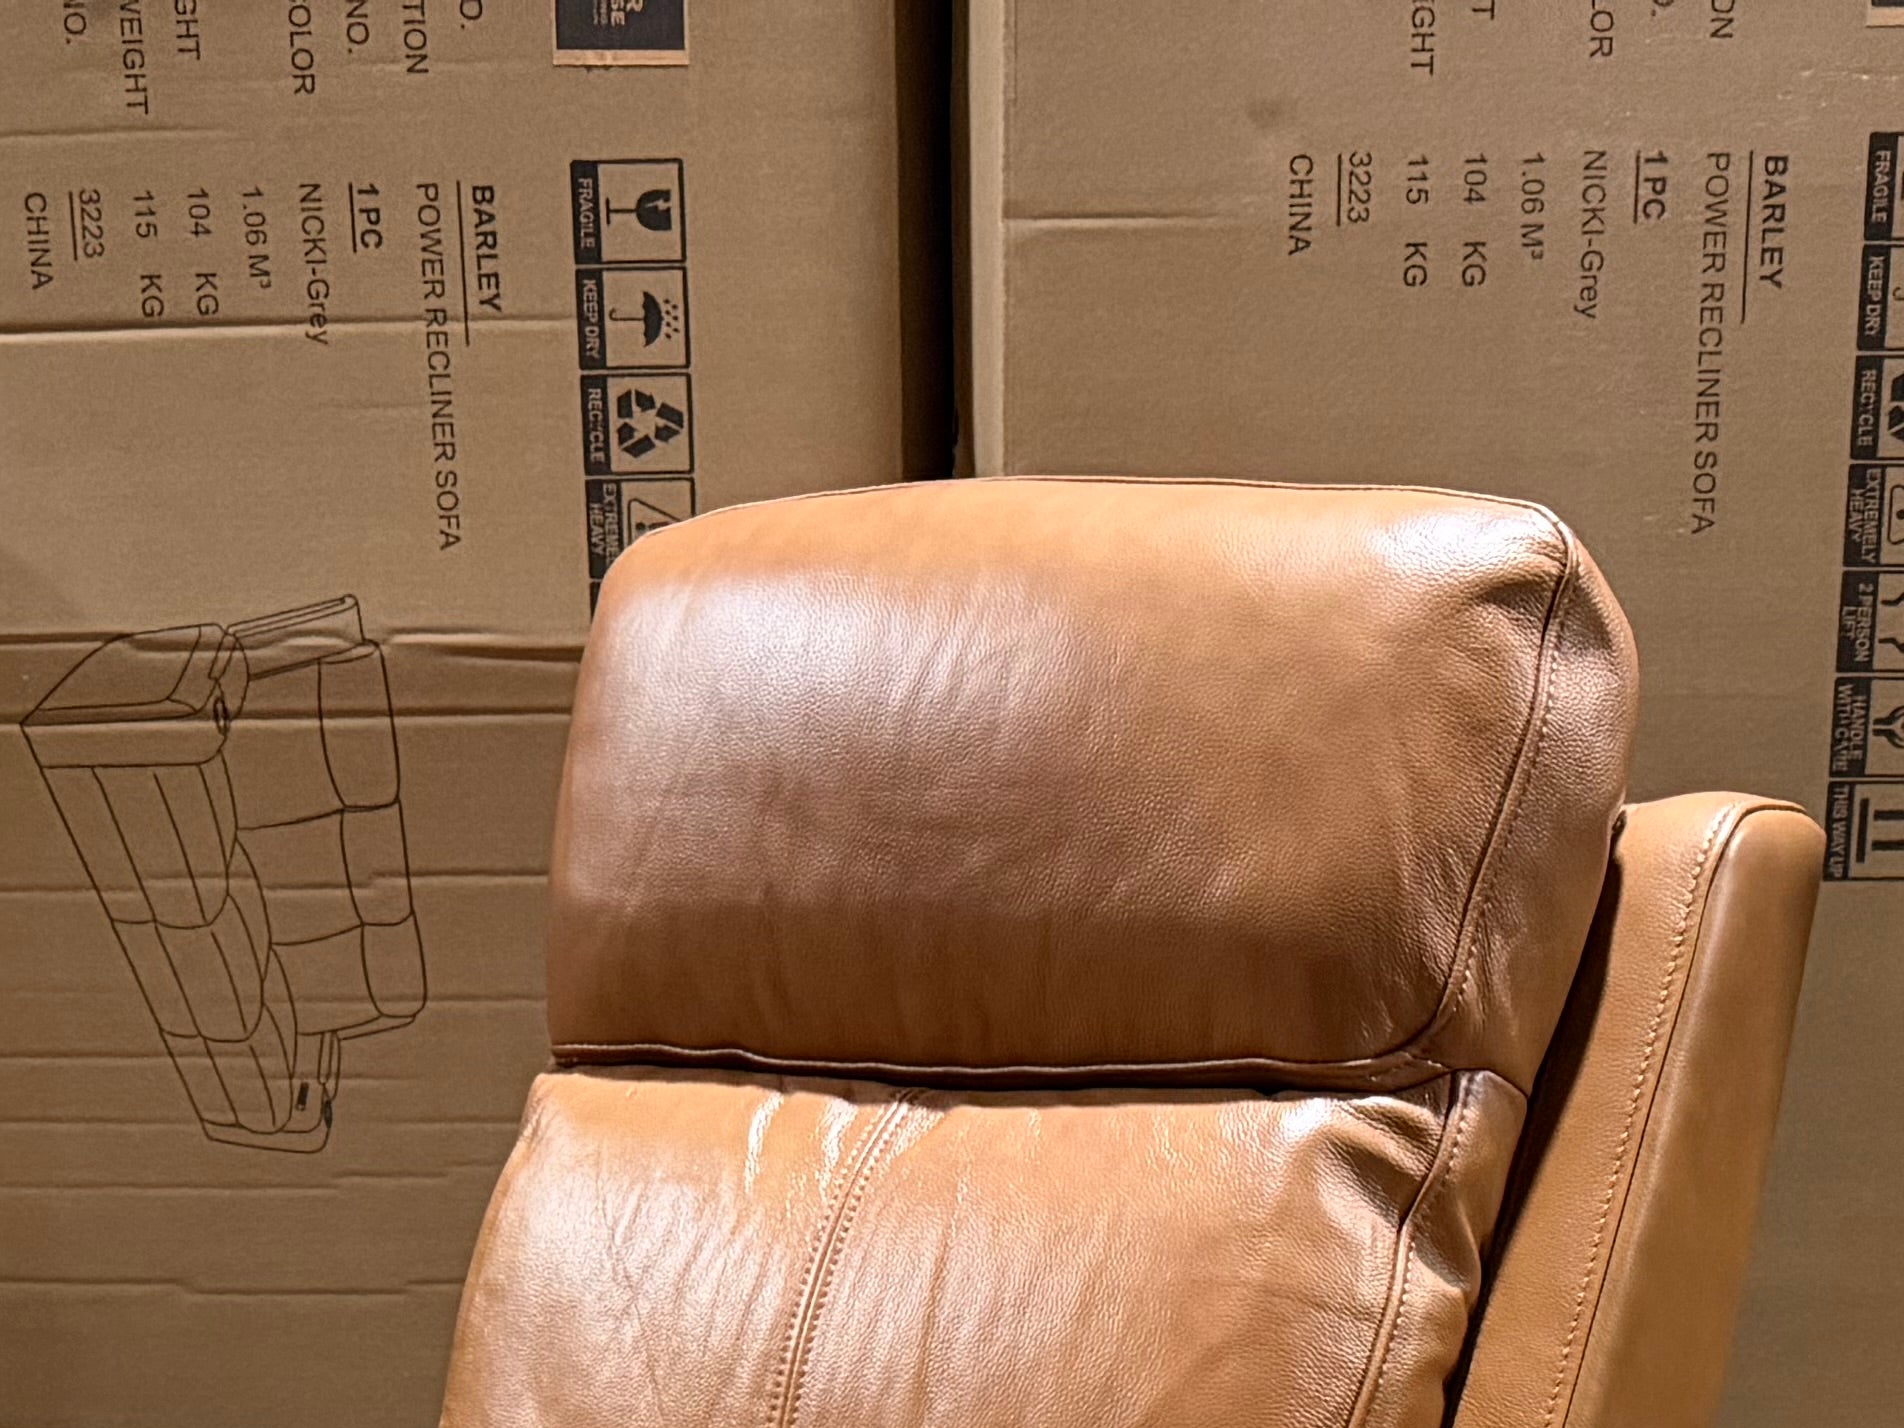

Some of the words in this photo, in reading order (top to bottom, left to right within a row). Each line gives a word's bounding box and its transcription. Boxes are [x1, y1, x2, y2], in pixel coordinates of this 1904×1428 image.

[288, 0, 315, 94] OLOR
[1411, 0, 1435, 75] GHT
[357, 183, 379, 196] 1
[1348, 151, 1372, 224] 3223
[1406, 154, 1429, 205] 115
[1463, 153, 1488, 205] 104
[1520, 152, 1546, 215] 1.06
[1644, 151, 1669, 165] 1
[1870, 150, 1892, 223] FRAGILE
[79, 188, 105, 259] 3223
[133, 190, 157, 238] 115
[187, 188, 212, 237] 104
[242, 186, 267, 246] 1.06
[358, 207, 383, 249] PC
[578, 177, 595, 249] FRAGILE
[1288, 154, 1314, 256] CHINA
[1642, 177, 1667, 221] PC
[1702, 152, 1731, 273] POWER
[1759, 155, 1789, 289] BARLEY
[24, 192, 53, 290] CHINA
[299, 183, 330, 345] NICKI-Grey
[417, 183, 445, 300] POWER
[472, 185, 502, 313] BARLEY
[1403, 241, 1428, 287] KG
[1462, 241, 1487, 288] KG
[1574, 150, 1607, 319] NICKI-Grey
[140, 274, 164, 318] KG
[195, 273, 219, 316] KG
[583, 279, 599, 323] KEEP
[1865, 255, 1885, 301] KEEP
[585, 325, 602, 359] DRY
[1864, 301, 1883, 336] DRY
[424, 308, 458, 463] RECLINER
[1695, 282, 1725, 444] RECLINER
[587, 388, 605, 463] RECYCLE
[1857, 369, 1877, 446] RECYCLE
[435, 469, 461, 551] SOFA
[1691, 449, 1718, 535] SOFA
[1848, 488, 1864, 542] HEAVY
[1861, 468, 1882, 563] EXTREMELY
[589, 503, 604, 555] HEAVY
[1859, 582, 1874, 593] 2
[1854, 597, 1873, 662] PERSON
[1849, 696, 1867, 761] HANDLE
[1832, 784, 1849, 820] THIS
